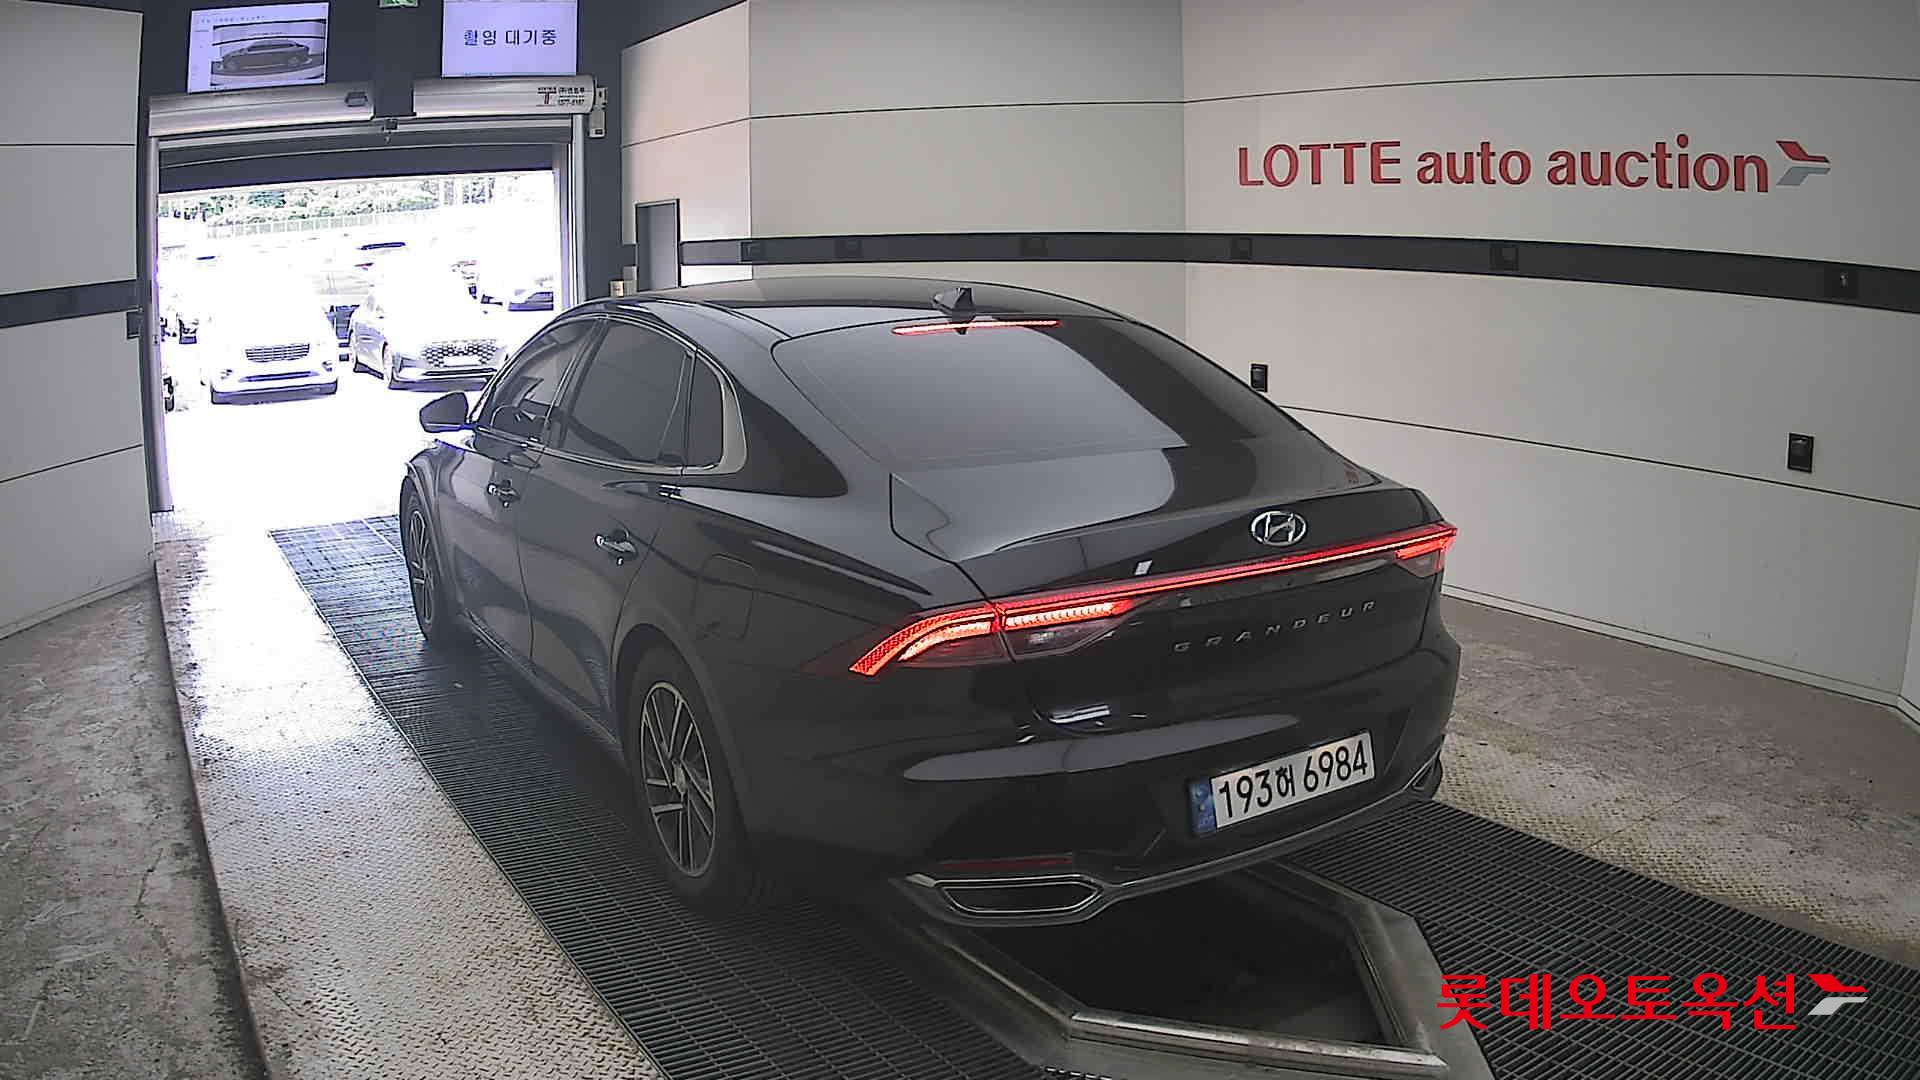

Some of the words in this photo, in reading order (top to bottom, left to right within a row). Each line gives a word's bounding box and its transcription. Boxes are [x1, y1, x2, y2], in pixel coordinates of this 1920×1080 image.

[505, 29, 558, 46] 대기중
[1238, 140, 1400, 186] LOTTE
[1417, 141, 1531, 185] auto
[1547, 134, 1769, 192] auction
[1173, 600, 1376, 652] GRANDEUR
[1219, 765, 1296, 819] 193허
[1302, 740, 1368, 792] 6984
